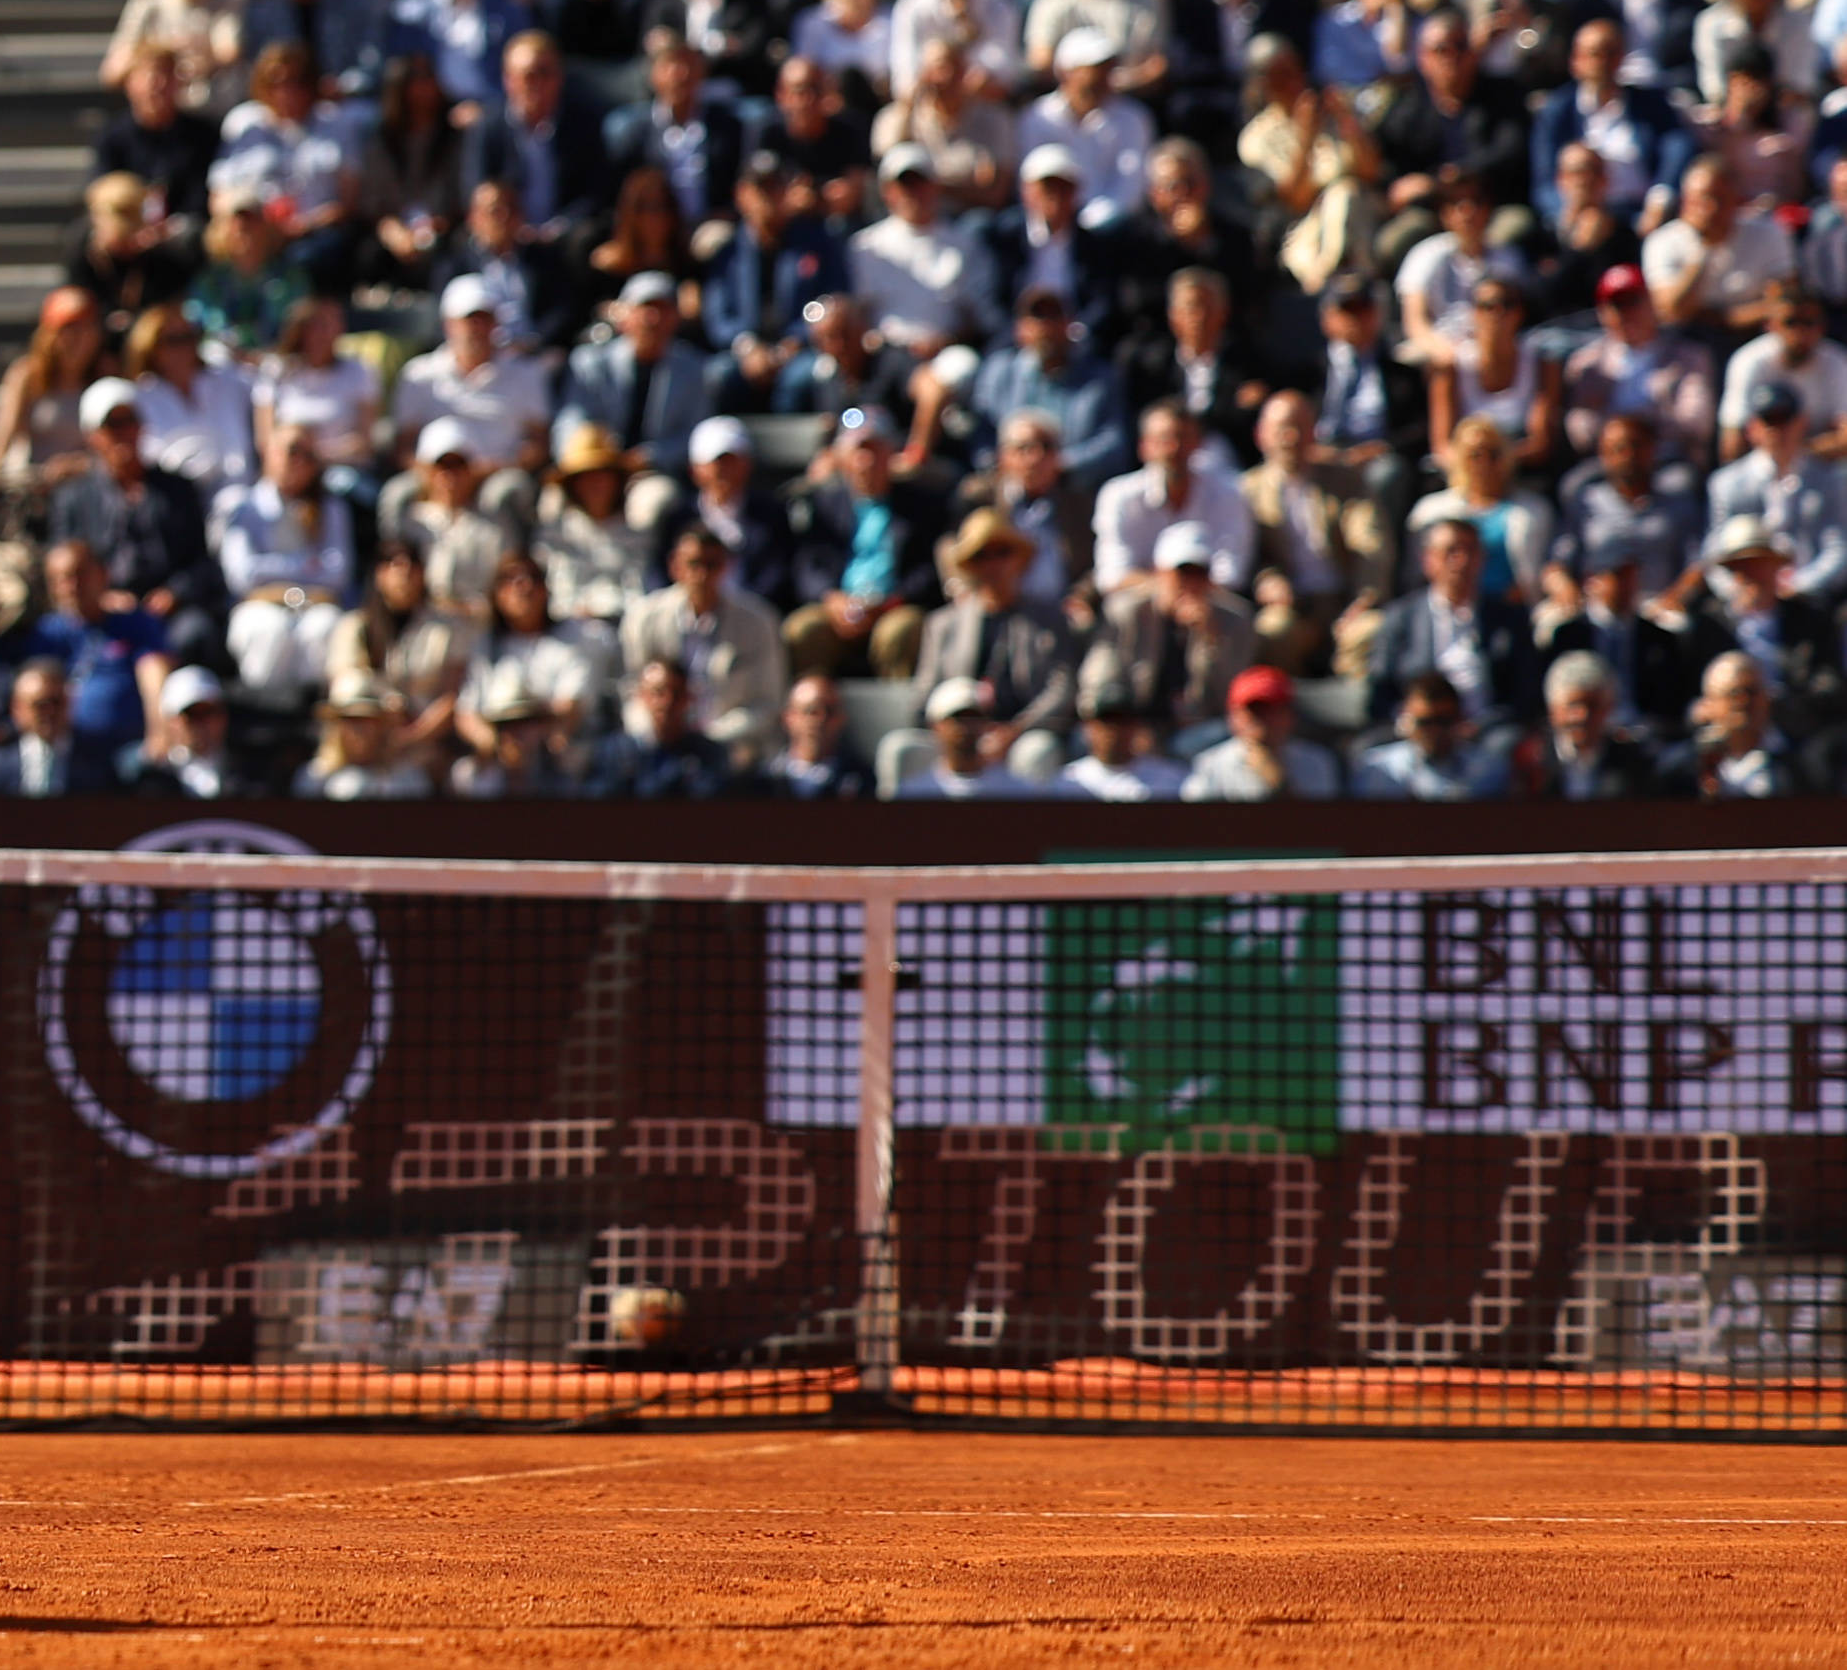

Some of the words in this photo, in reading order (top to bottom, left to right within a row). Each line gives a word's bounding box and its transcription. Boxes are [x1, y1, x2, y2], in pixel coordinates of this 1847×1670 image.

[1423, 894, 1720, 994] BNL
[1423, 1020, 1735, 1111] BNP
[938, 1120, 1768, 1364] TOUR
